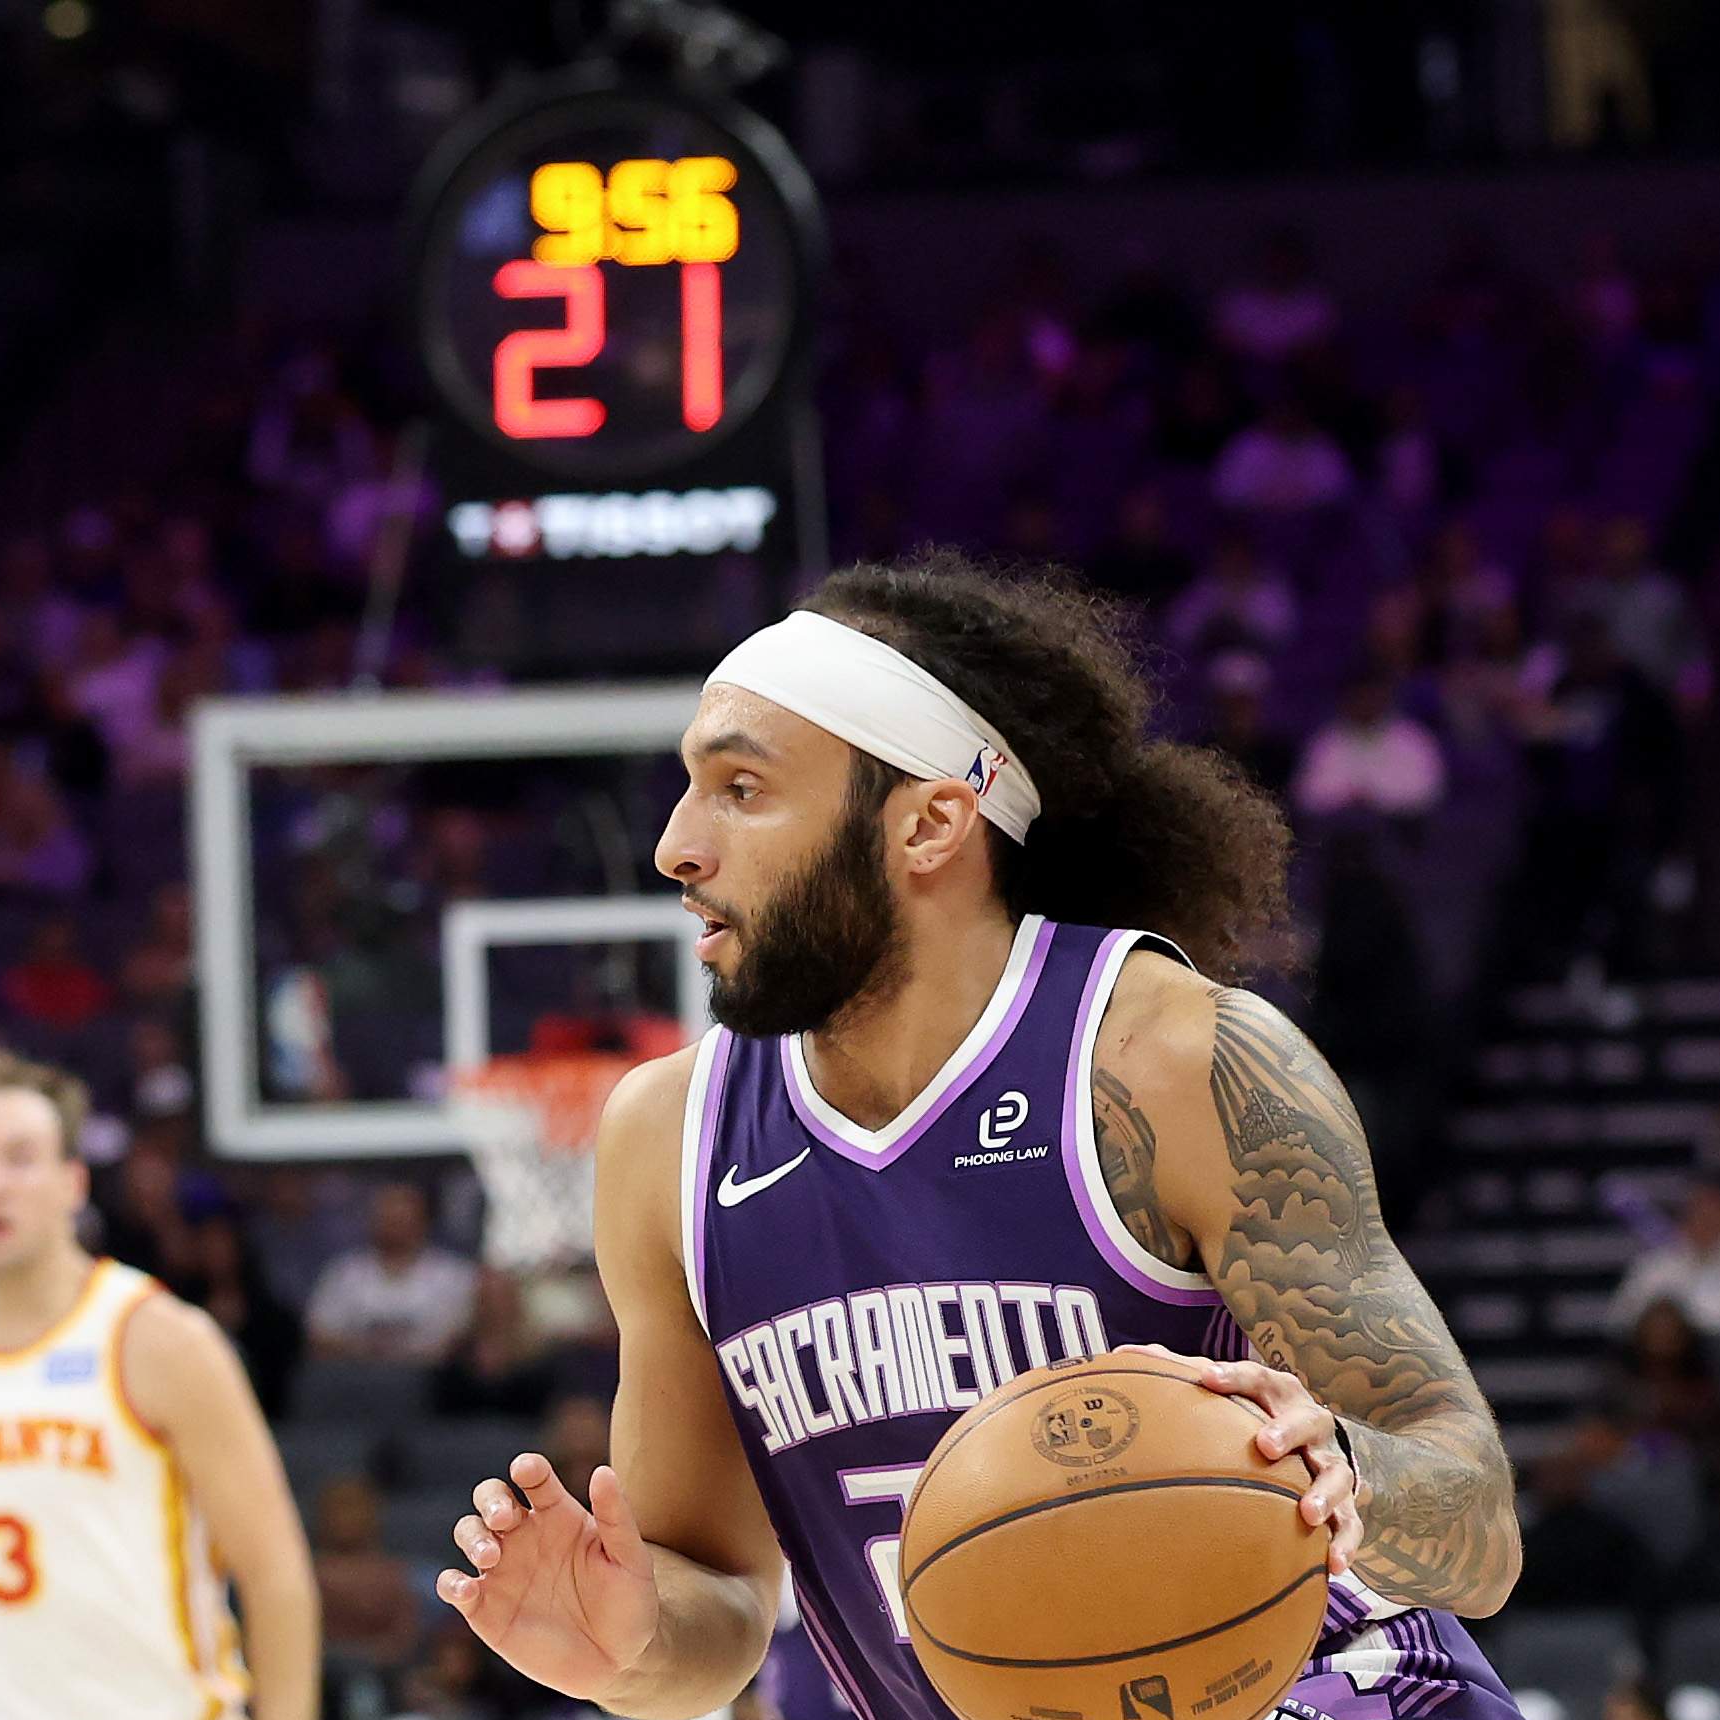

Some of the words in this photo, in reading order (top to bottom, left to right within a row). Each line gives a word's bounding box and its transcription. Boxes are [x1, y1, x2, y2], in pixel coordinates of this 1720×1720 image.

[492, 259, 724, 439] 21
[954, 1150, 1014, 1169] PHOONG
[1016, 1145, 1049, 1160] LAW
